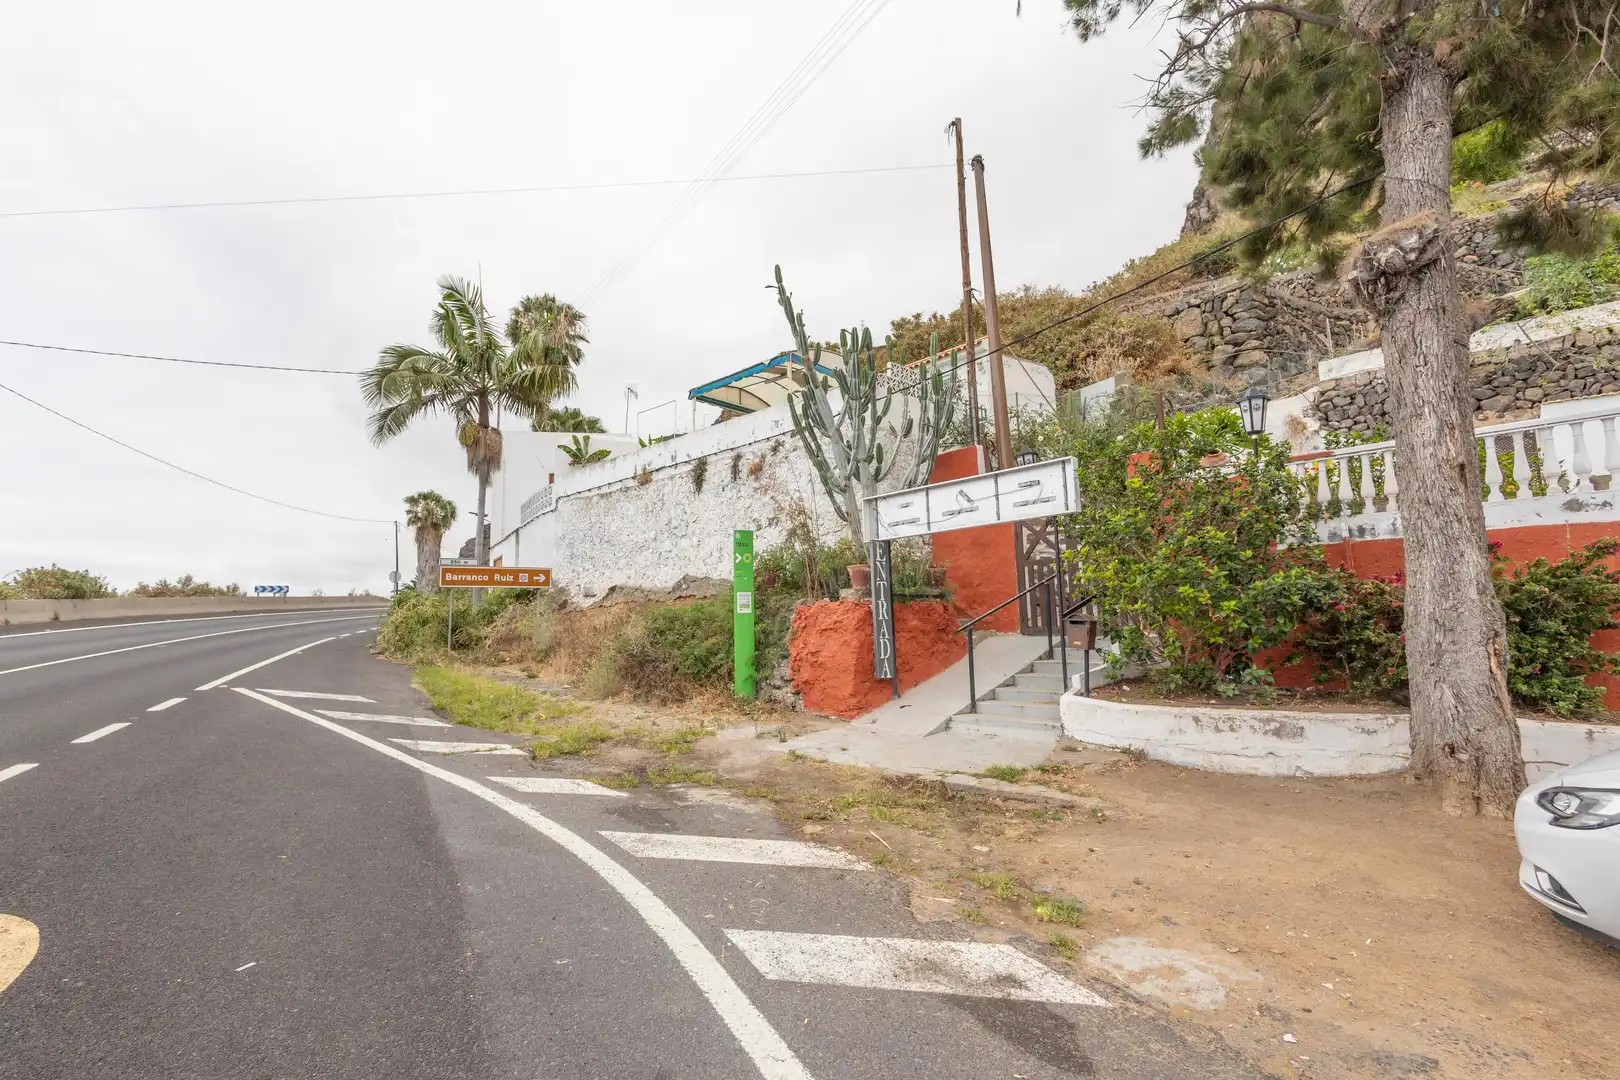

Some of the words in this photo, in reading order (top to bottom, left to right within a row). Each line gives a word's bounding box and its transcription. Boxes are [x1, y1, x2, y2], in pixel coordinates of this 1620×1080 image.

[445, 573, 489, 581] Barranco
[494, 573, 514, 582] Ruiz
[875, 541, 892, 678] ENTRADA
